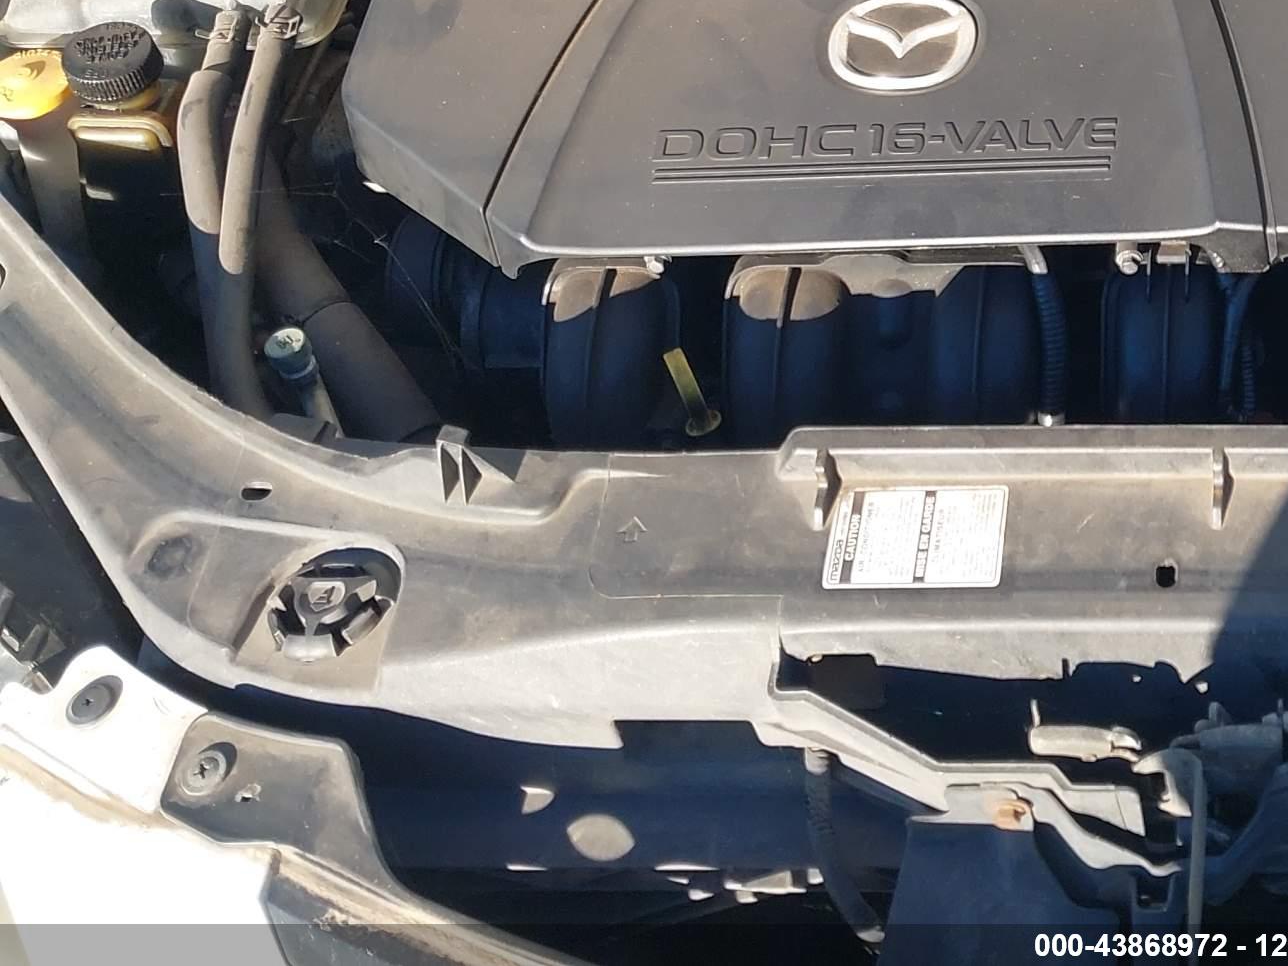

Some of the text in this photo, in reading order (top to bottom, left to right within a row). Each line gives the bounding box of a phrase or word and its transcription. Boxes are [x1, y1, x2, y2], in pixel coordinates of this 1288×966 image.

[652, 117, 1118, 162] DOHC 16-VALVE
[844, 514, 861, 562] CAUTION
[914, 496, 936, 578] MISE EN GARDE
